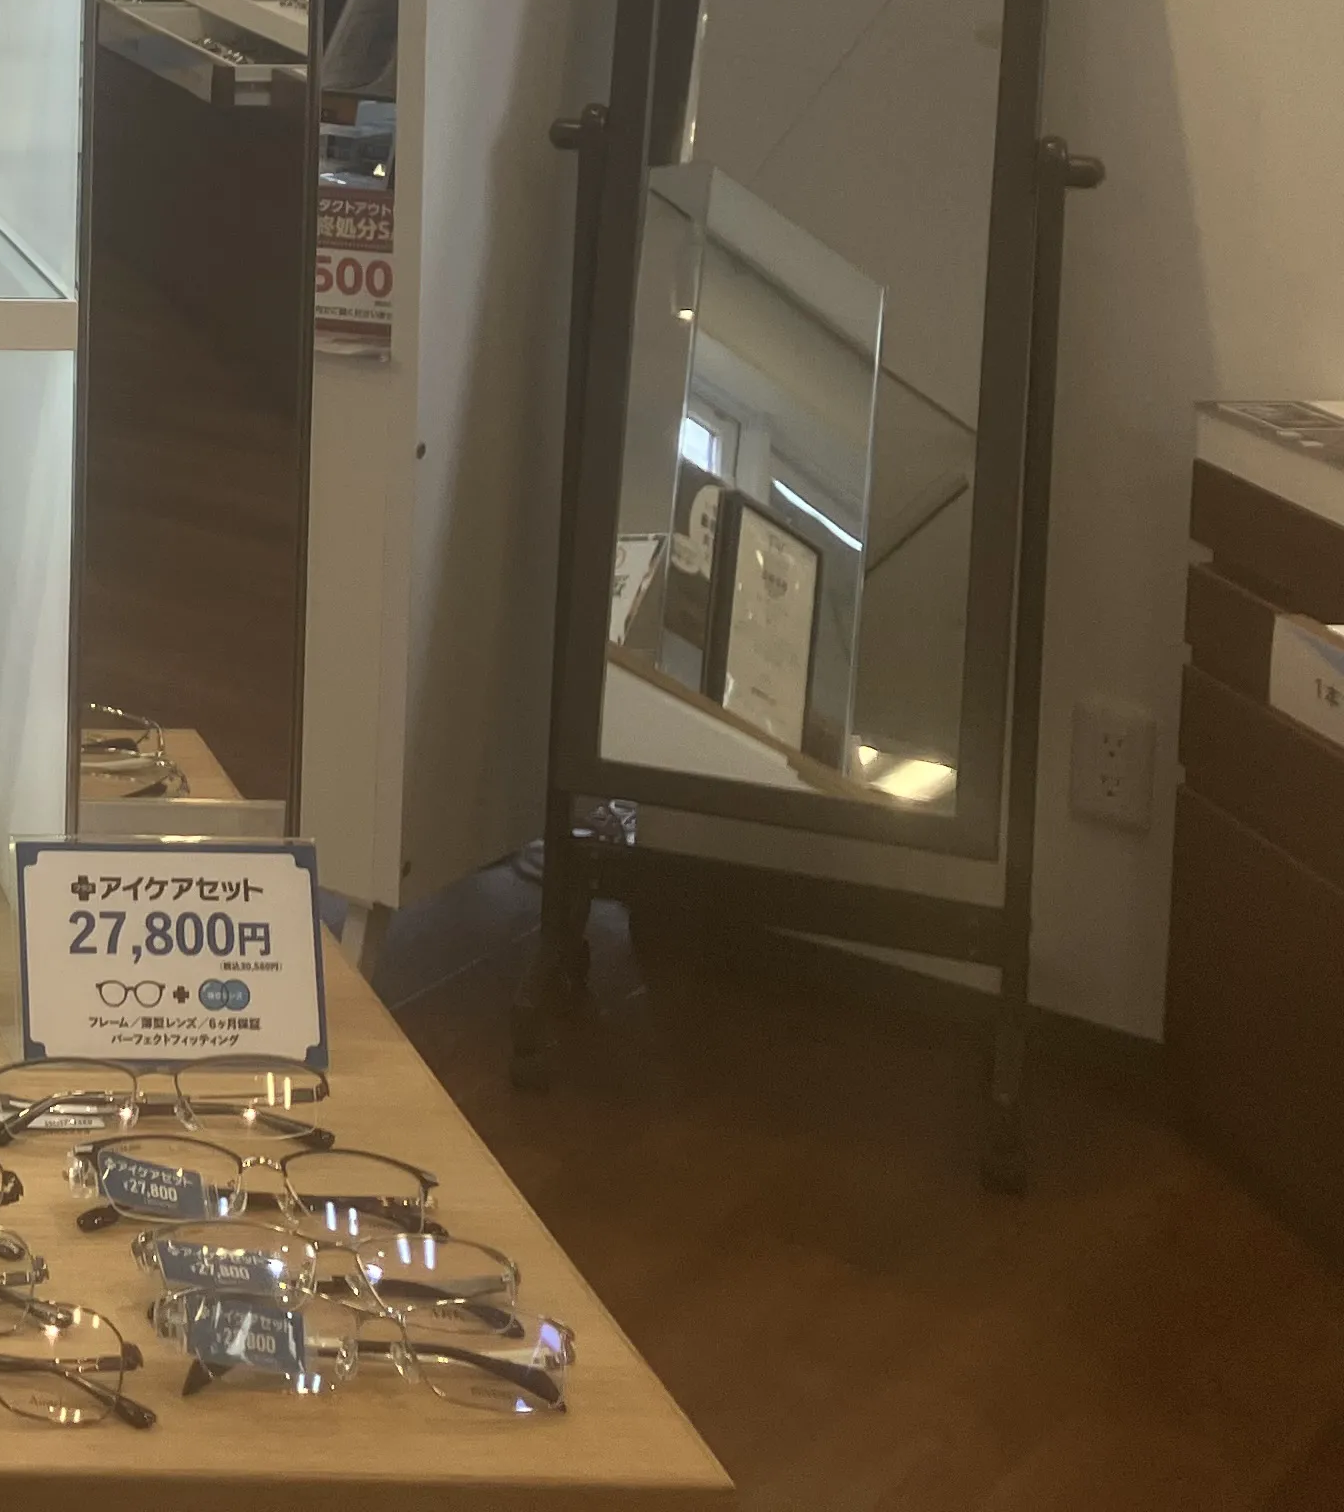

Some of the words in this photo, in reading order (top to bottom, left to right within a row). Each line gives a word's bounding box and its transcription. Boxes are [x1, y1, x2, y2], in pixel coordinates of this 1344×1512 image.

[99, 875, 264, 903] アイケアセット
[68, 910, 272, 965] 27,800円
[123, 1177, 179, 1202] ¥27,800
